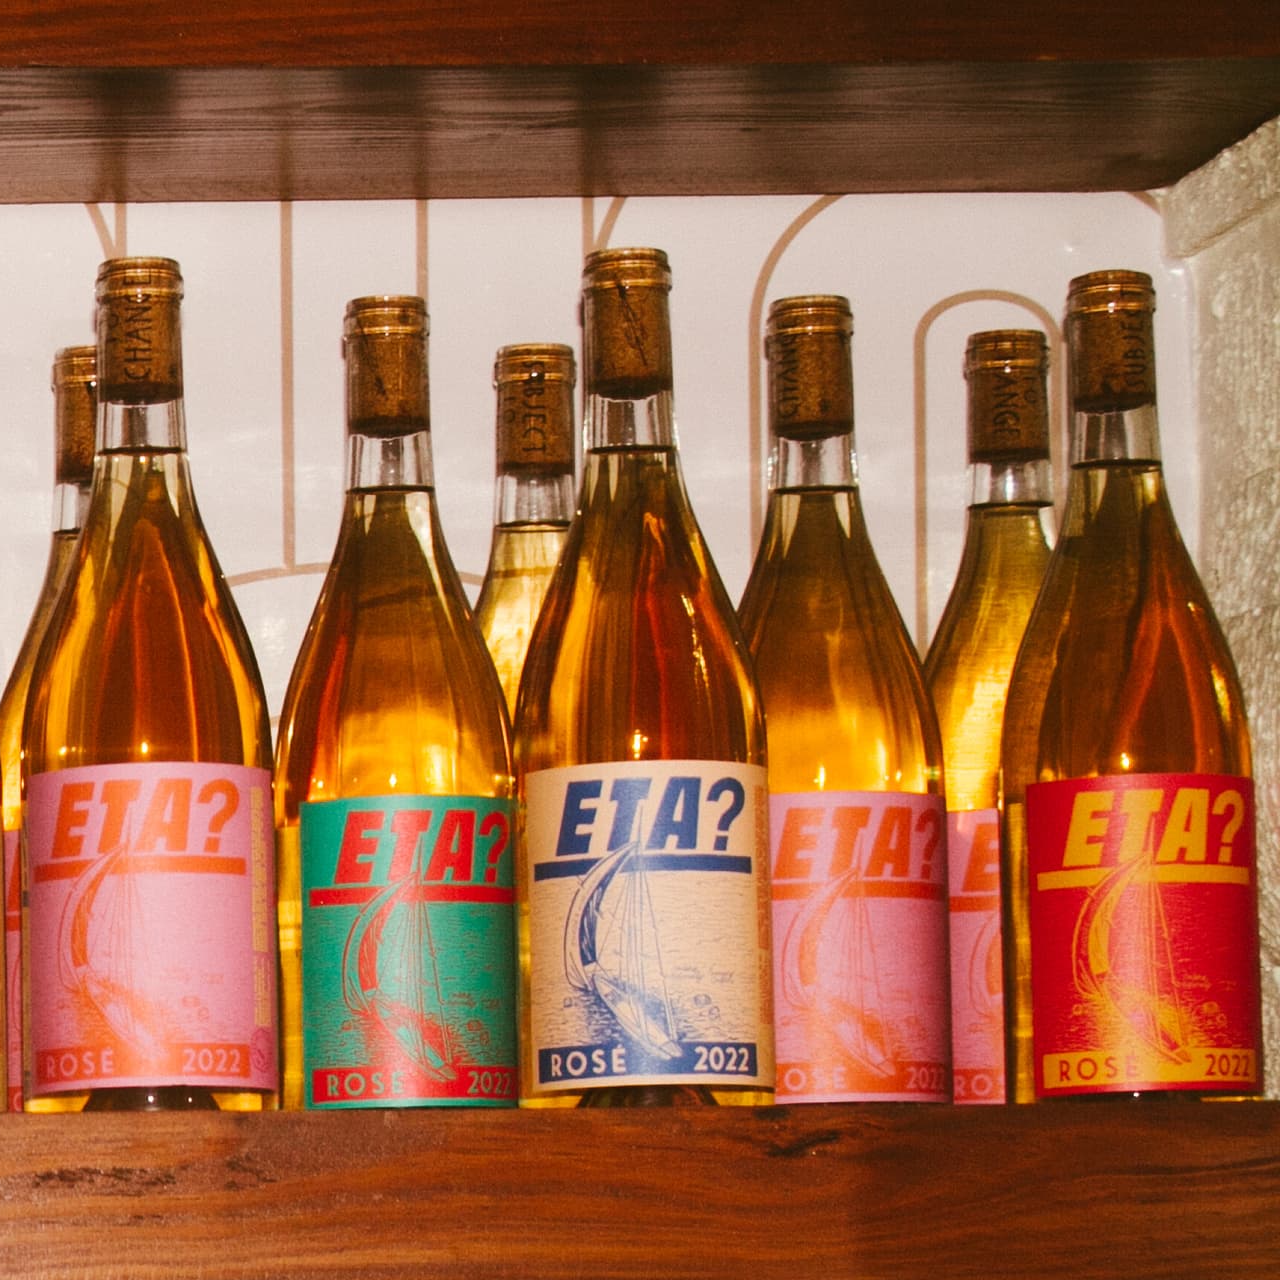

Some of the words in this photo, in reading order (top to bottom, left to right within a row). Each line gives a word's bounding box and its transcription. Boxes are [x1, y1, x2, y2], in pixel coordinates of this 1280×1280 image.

[50, 778, 241, 860] ETA?
[333, 809, 510, 885] ETA?
[555, 776, 747, 858] ETA?
[773, 806, 941, 882] ETA?
[1062, 788, 1242, 869] ETA?
[182, 1048, 241, 1073] 2022
[466, 1070, 513, 1096] 2022
[550, 1043, 628, 1078] ROSÉ
[693, 1046, 750, 1073] 2022
[1204, 1054, 1250, 1078] 2022
